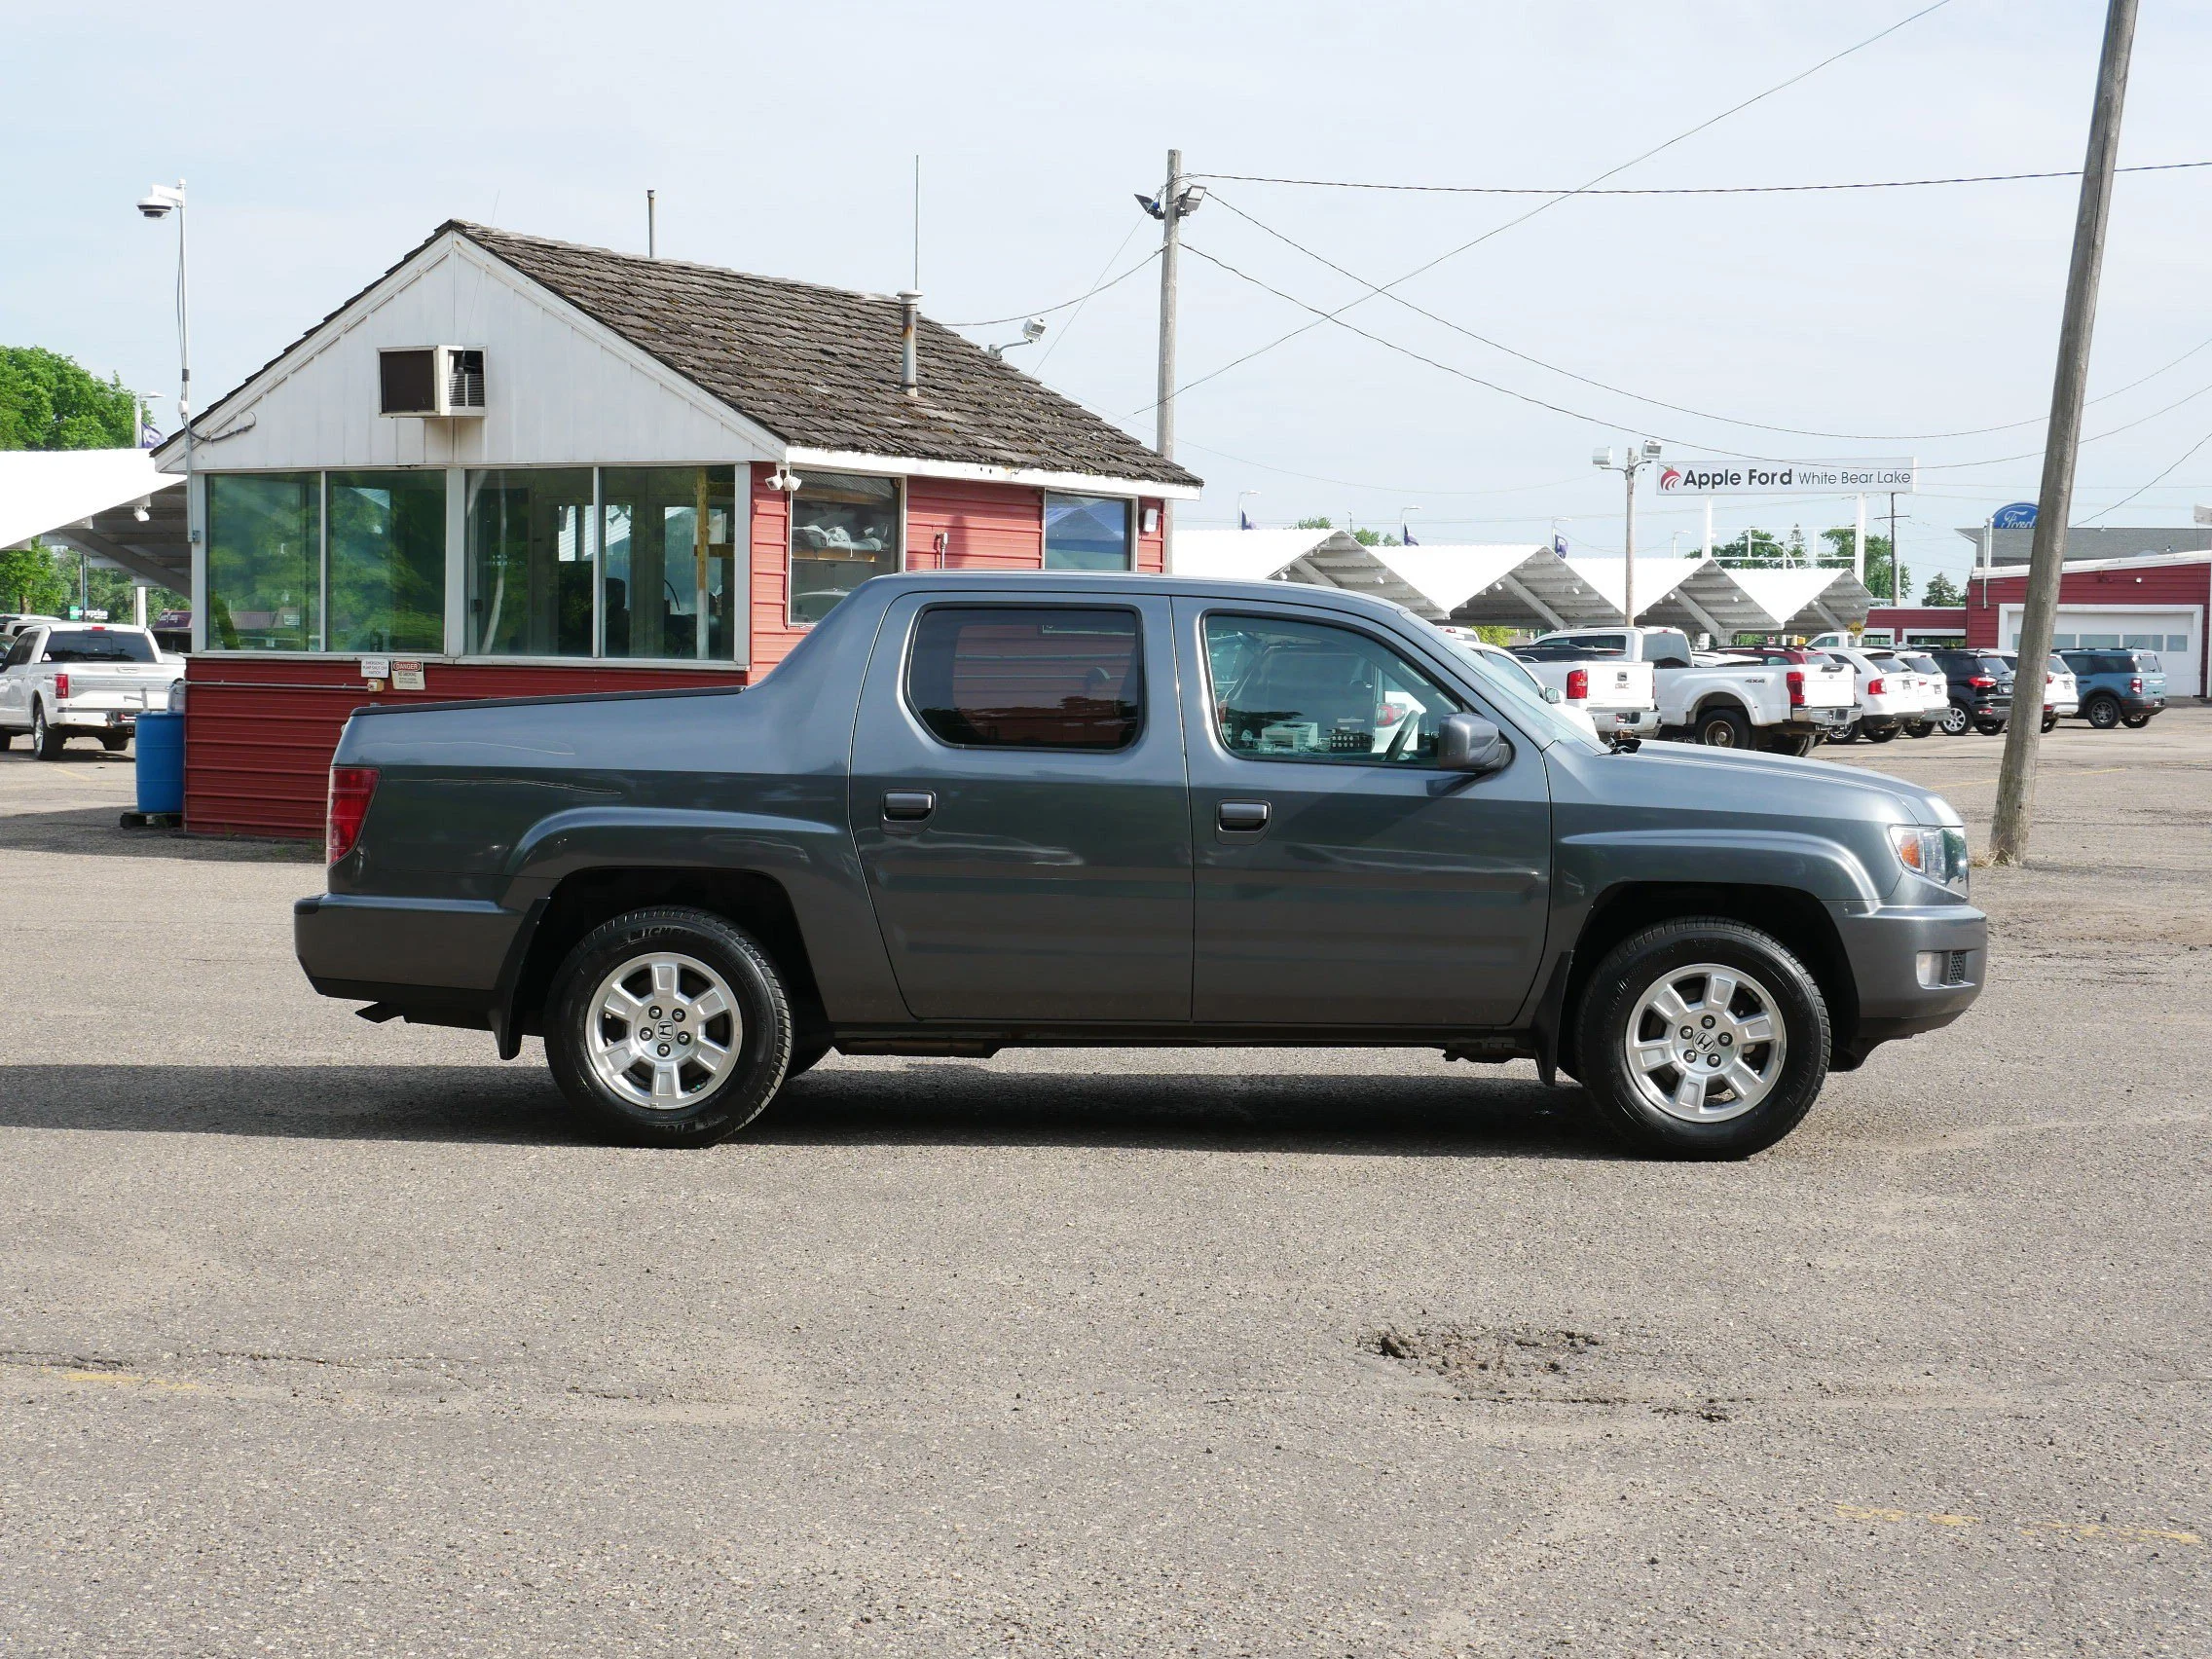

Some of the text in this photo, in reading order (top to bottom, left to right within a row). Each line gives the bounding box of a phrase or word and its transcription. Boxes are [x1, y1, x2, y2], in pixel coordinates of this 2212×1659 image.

[1683, 468, 1911, 489] Apple Ford White Bear Lake
